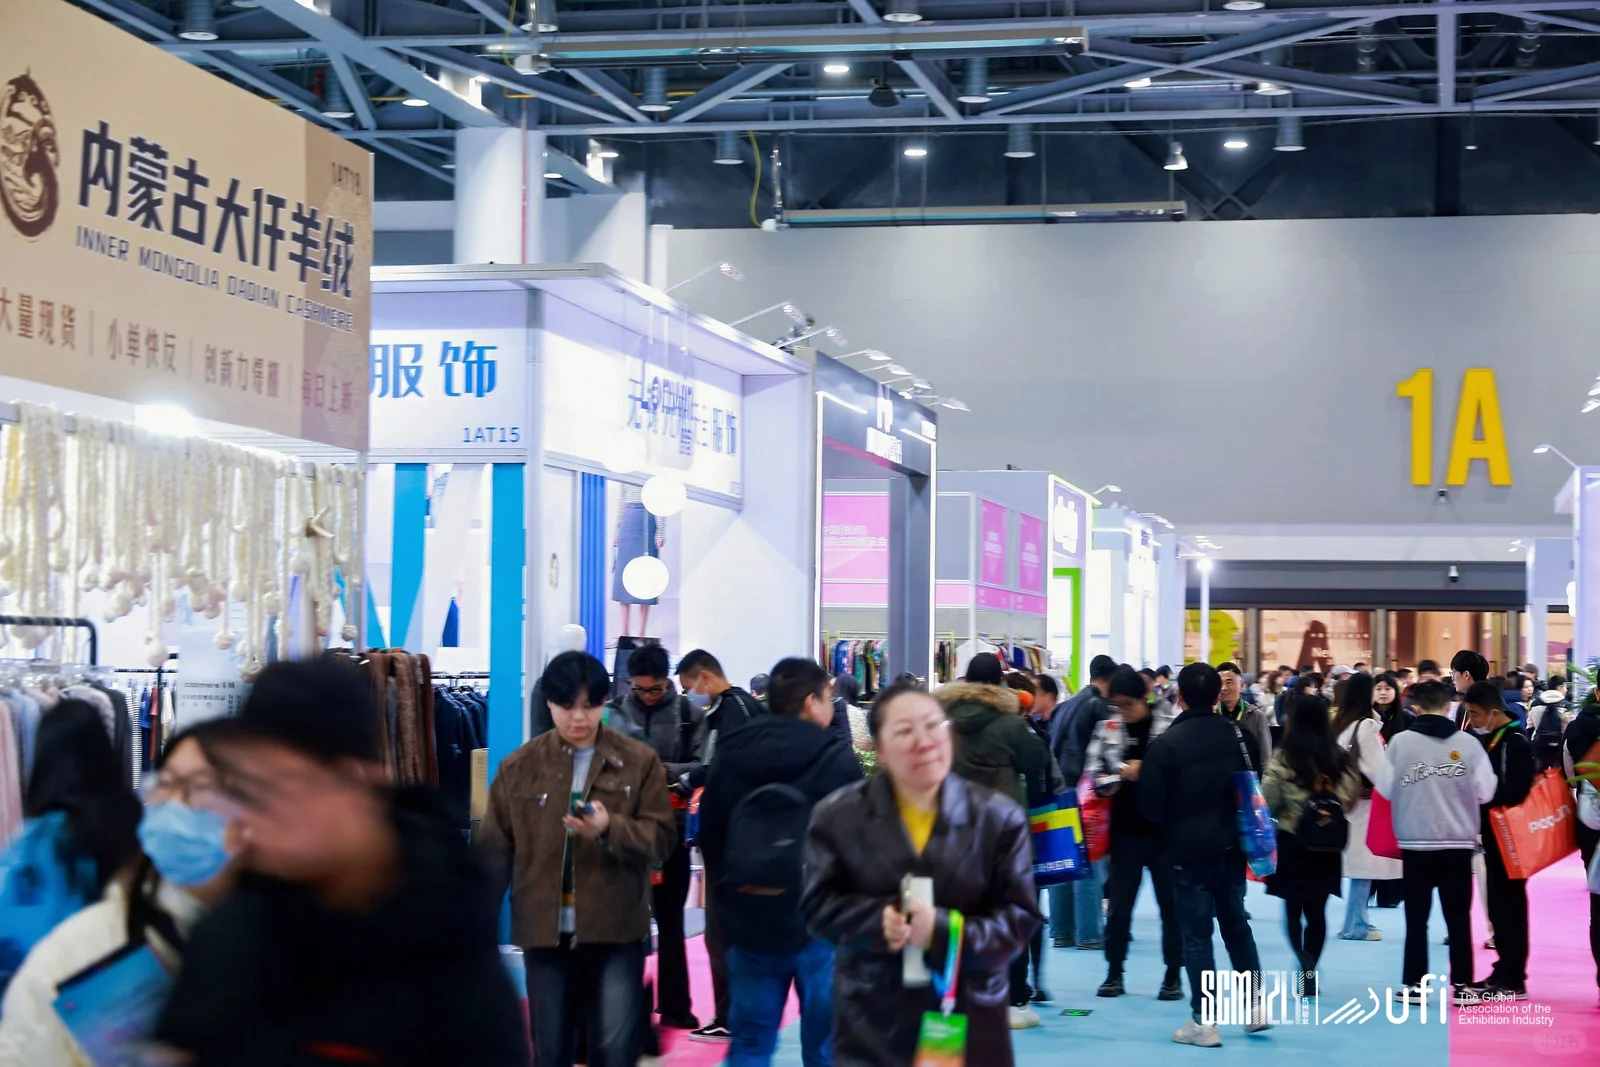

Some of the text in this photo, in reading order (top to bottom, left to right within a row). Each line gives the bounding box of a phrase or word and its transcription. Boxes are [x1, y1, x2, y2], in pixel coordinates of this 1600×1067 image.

[76, 224, 130, 262] INNER
[138, 245, 220, 291] MONGOLIA
[285, 293, 355, 334] CASHMERE
[368, 340, 498, 398] 服饰
[462, 426, 520, 443] 1AT15
[1396, 368, 1512, 486] 1A
